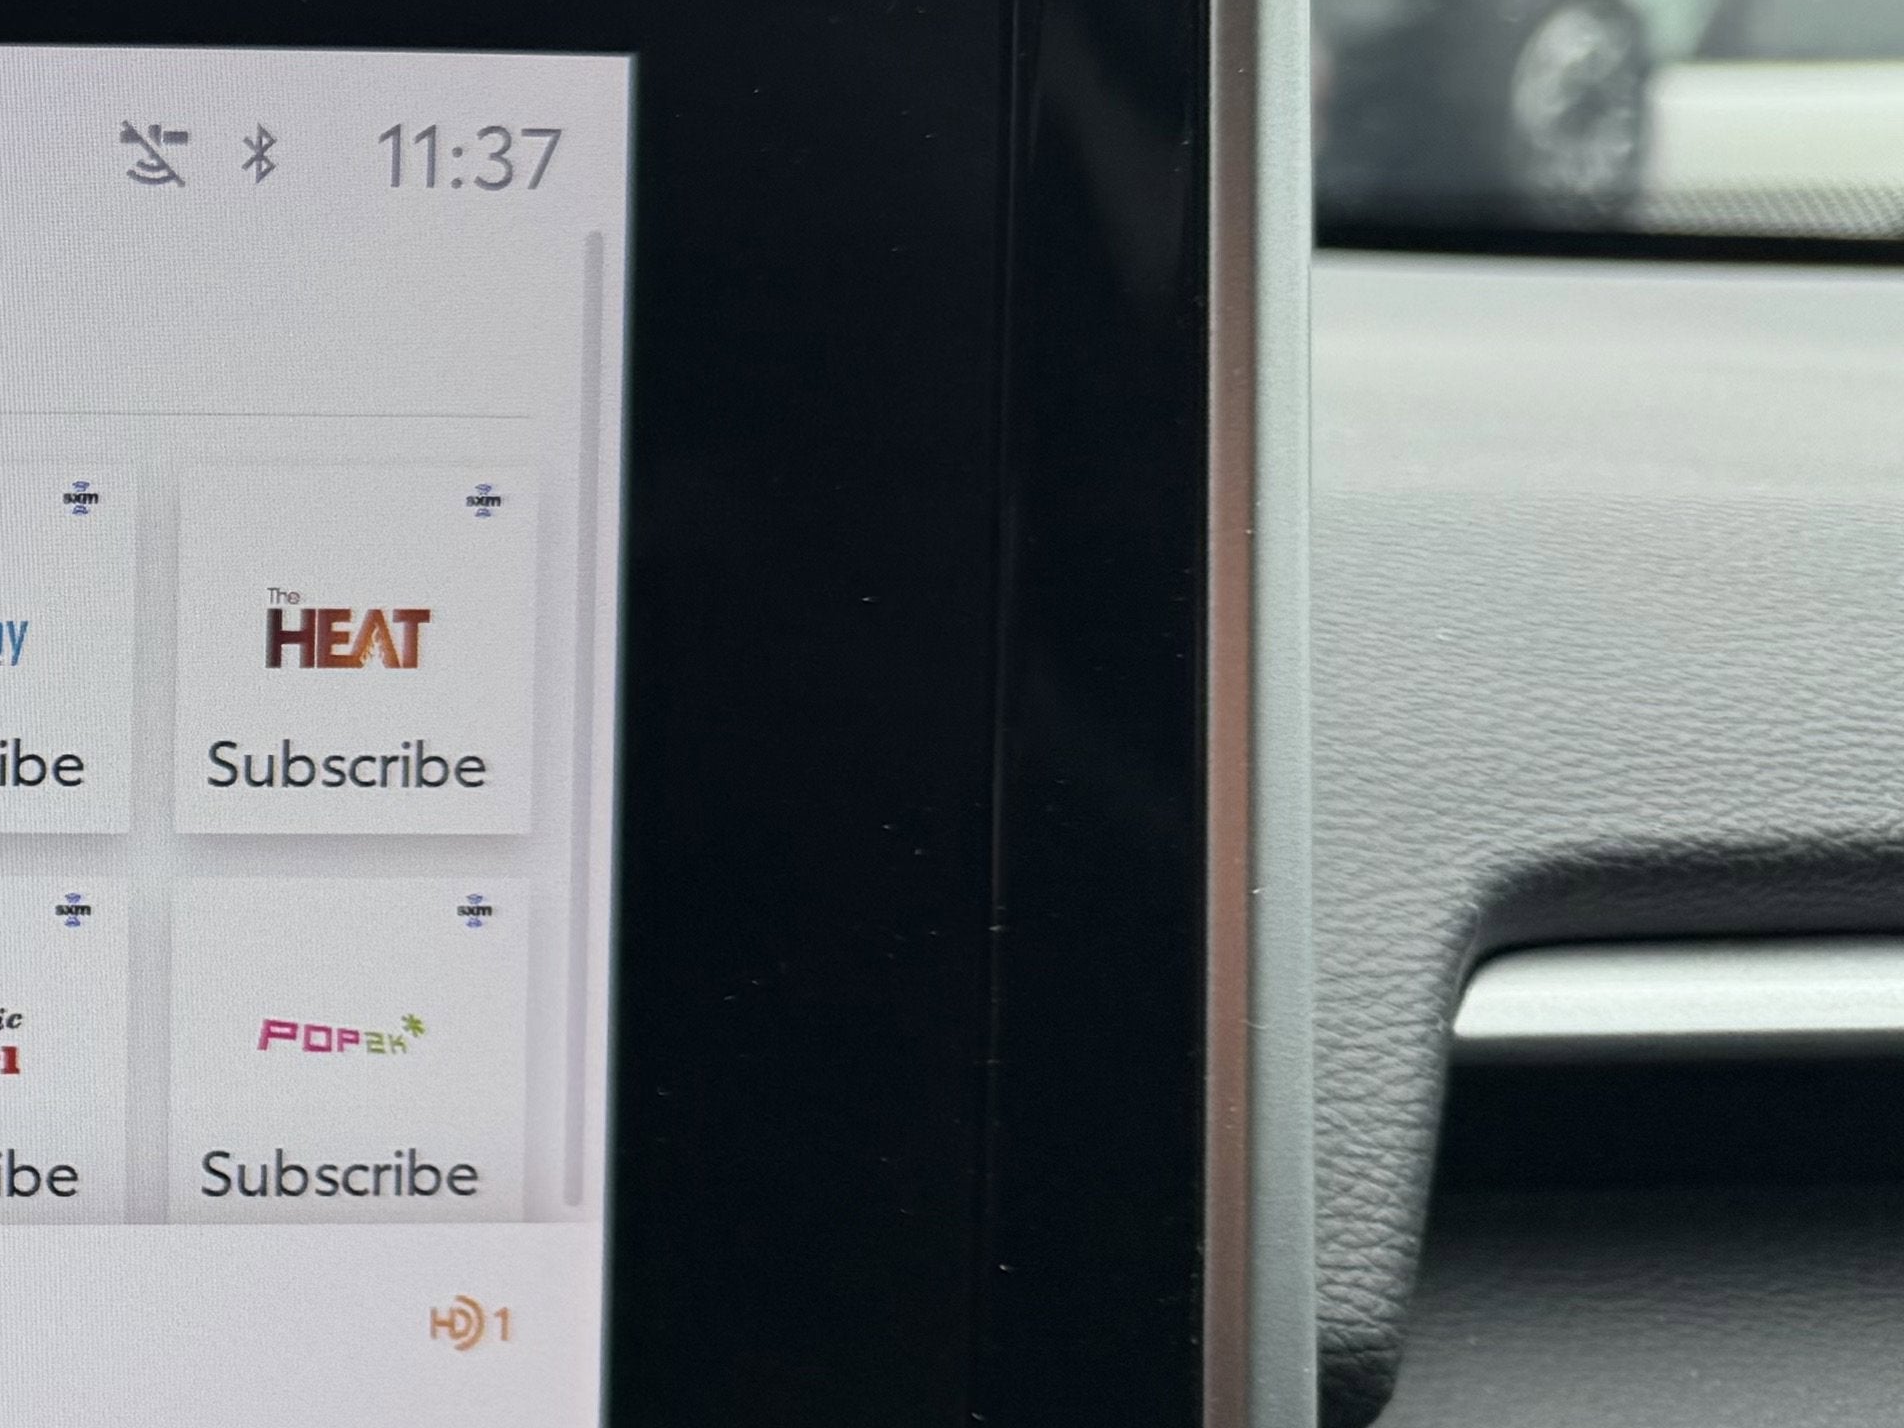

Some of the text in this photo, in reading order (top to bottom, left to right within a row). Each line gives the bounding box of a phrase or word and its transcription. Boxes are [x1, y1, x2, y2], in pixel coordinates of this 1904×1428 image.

[378, 123, 563, 191] 11:37
[266, 586, 302, 606] The
[265, 607, 432, 669] HEAT
[207, 739, 487, 789] Subscribe
[201, 1148, 480, 1198] Subscribe
